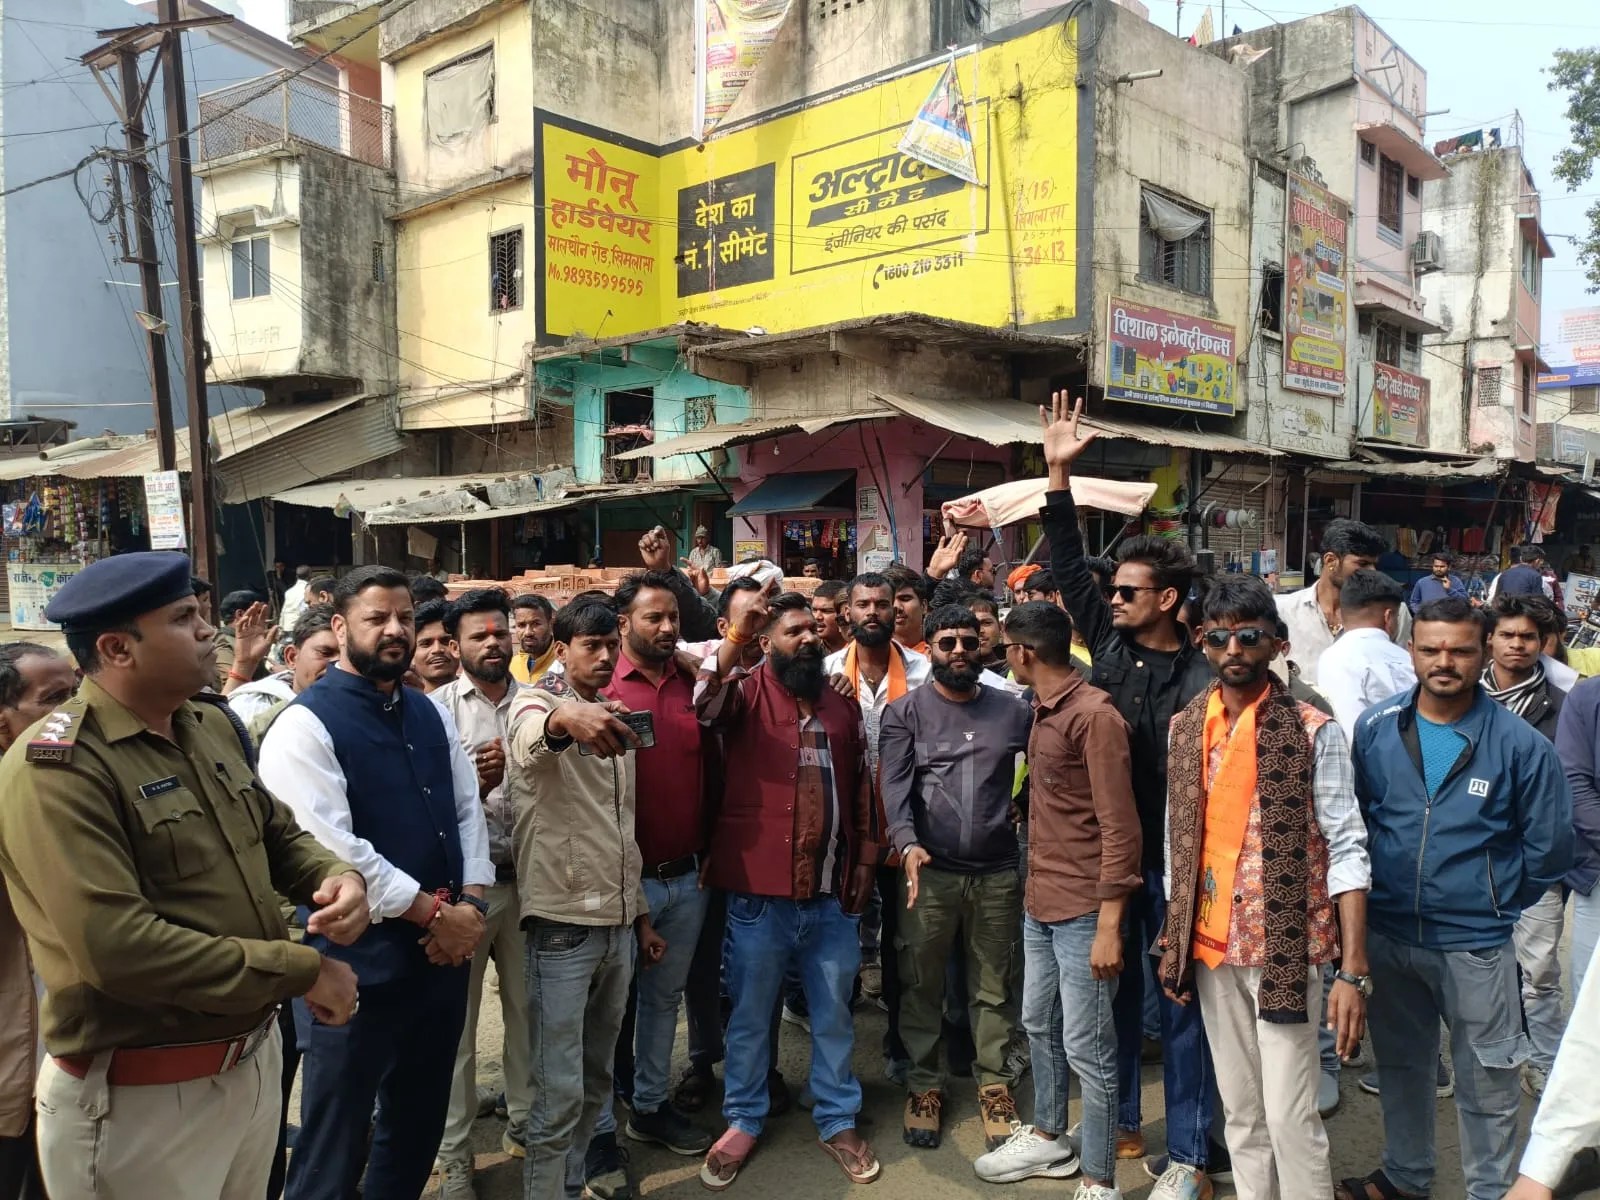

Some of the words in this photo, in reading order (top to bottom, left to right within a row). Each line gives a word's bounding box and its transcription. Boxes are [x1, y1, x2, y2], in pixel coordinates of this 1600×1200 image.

[565, 147, 640, 213] मोनू
[551, 197, 654, 244] हार्डवेयर
[695, 198, 725, 228] देश
[730, 193, 756, 219] का
[719, 226, 768, 264] सीमेंट
[824, 224, 883, 253] इंजीनियर
[887, 214, 908, 236] की
[912, 207, 950, 229] पसंद
[884, 262, 909, 281] 1800
[912, 258, 932, 276] 210
[934, 251, 963, 272] 3311
[1114, 308, 1159, 342] विशाल
